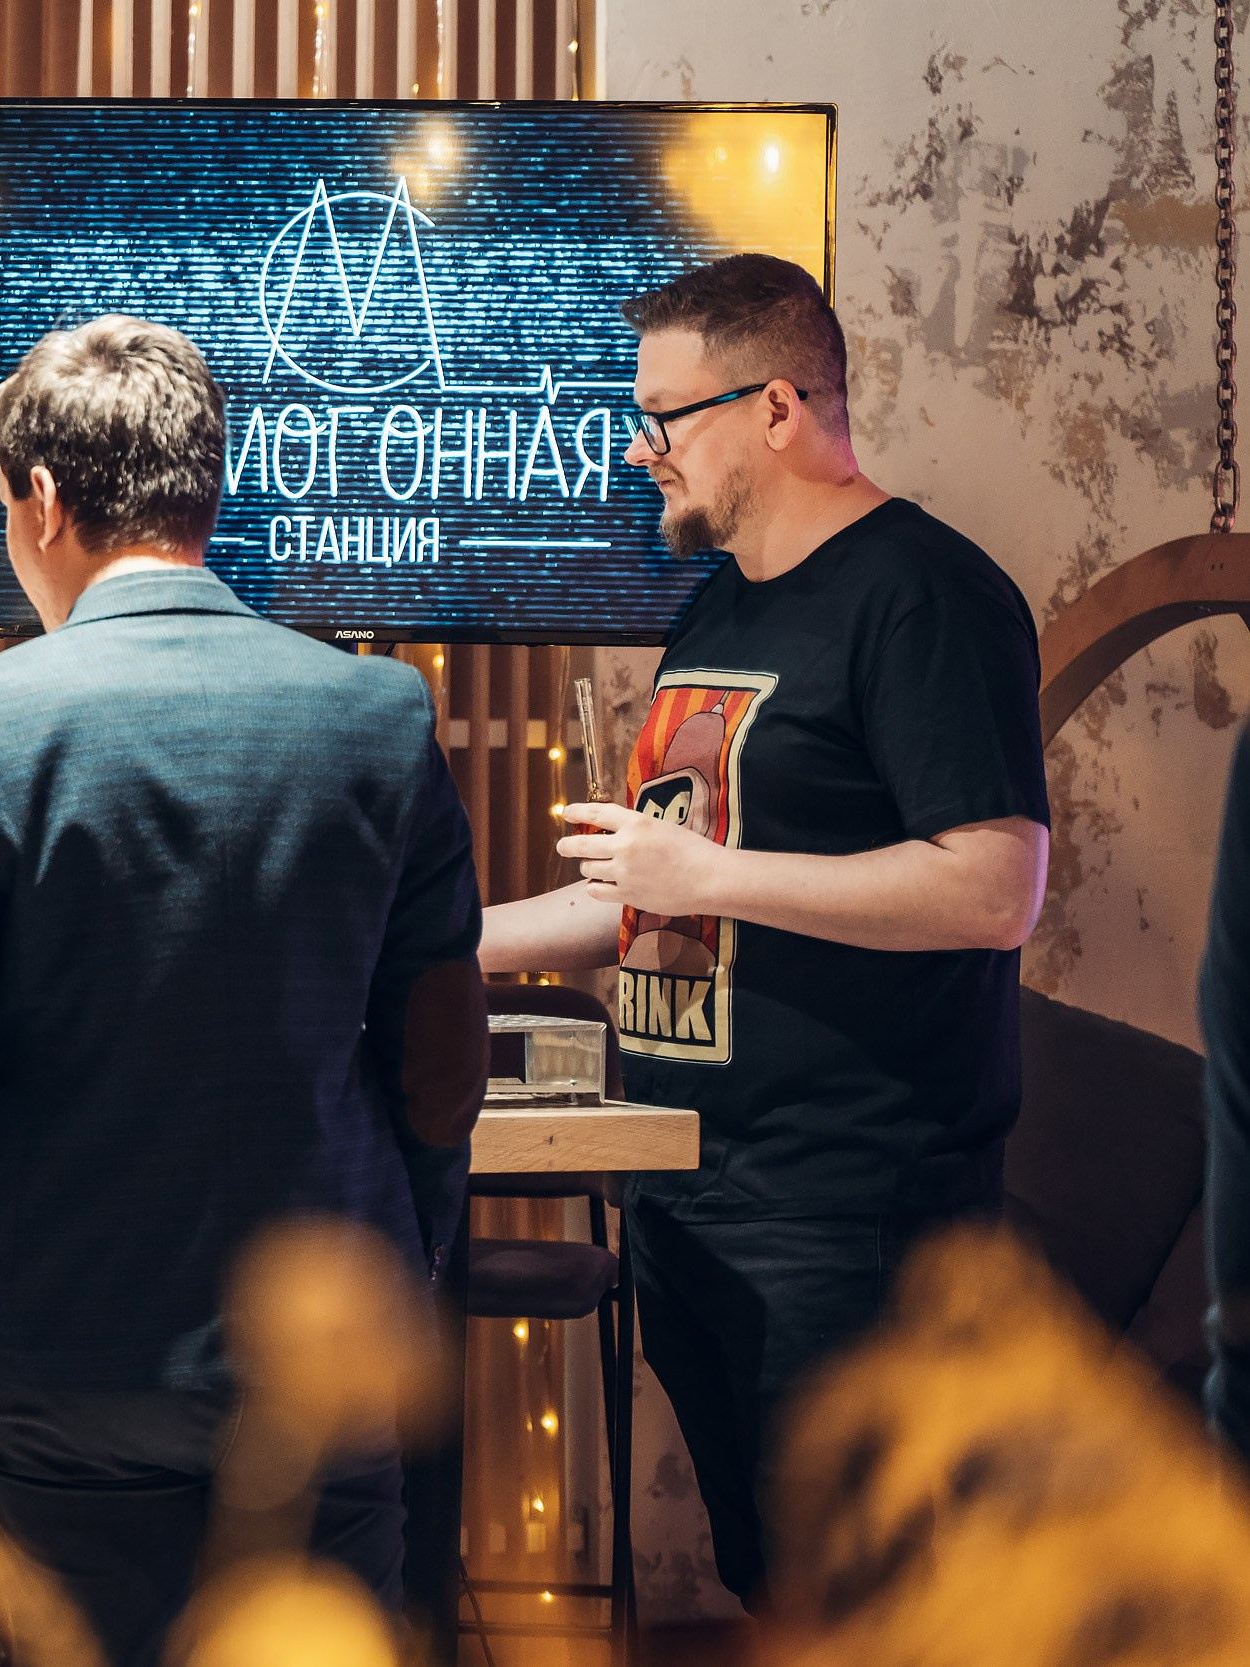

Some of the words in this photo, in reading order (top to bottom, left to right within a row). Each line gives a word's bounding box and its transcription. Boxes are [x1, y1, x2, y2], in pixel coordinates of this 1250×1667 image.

[225, 403, 611, 501] МОГОННАЯ
[268, 515, 440, 568] СТАНЦИЯ
[335, 630, 375, 639] ASANO
[618, 969, 713, 1041] RINK
